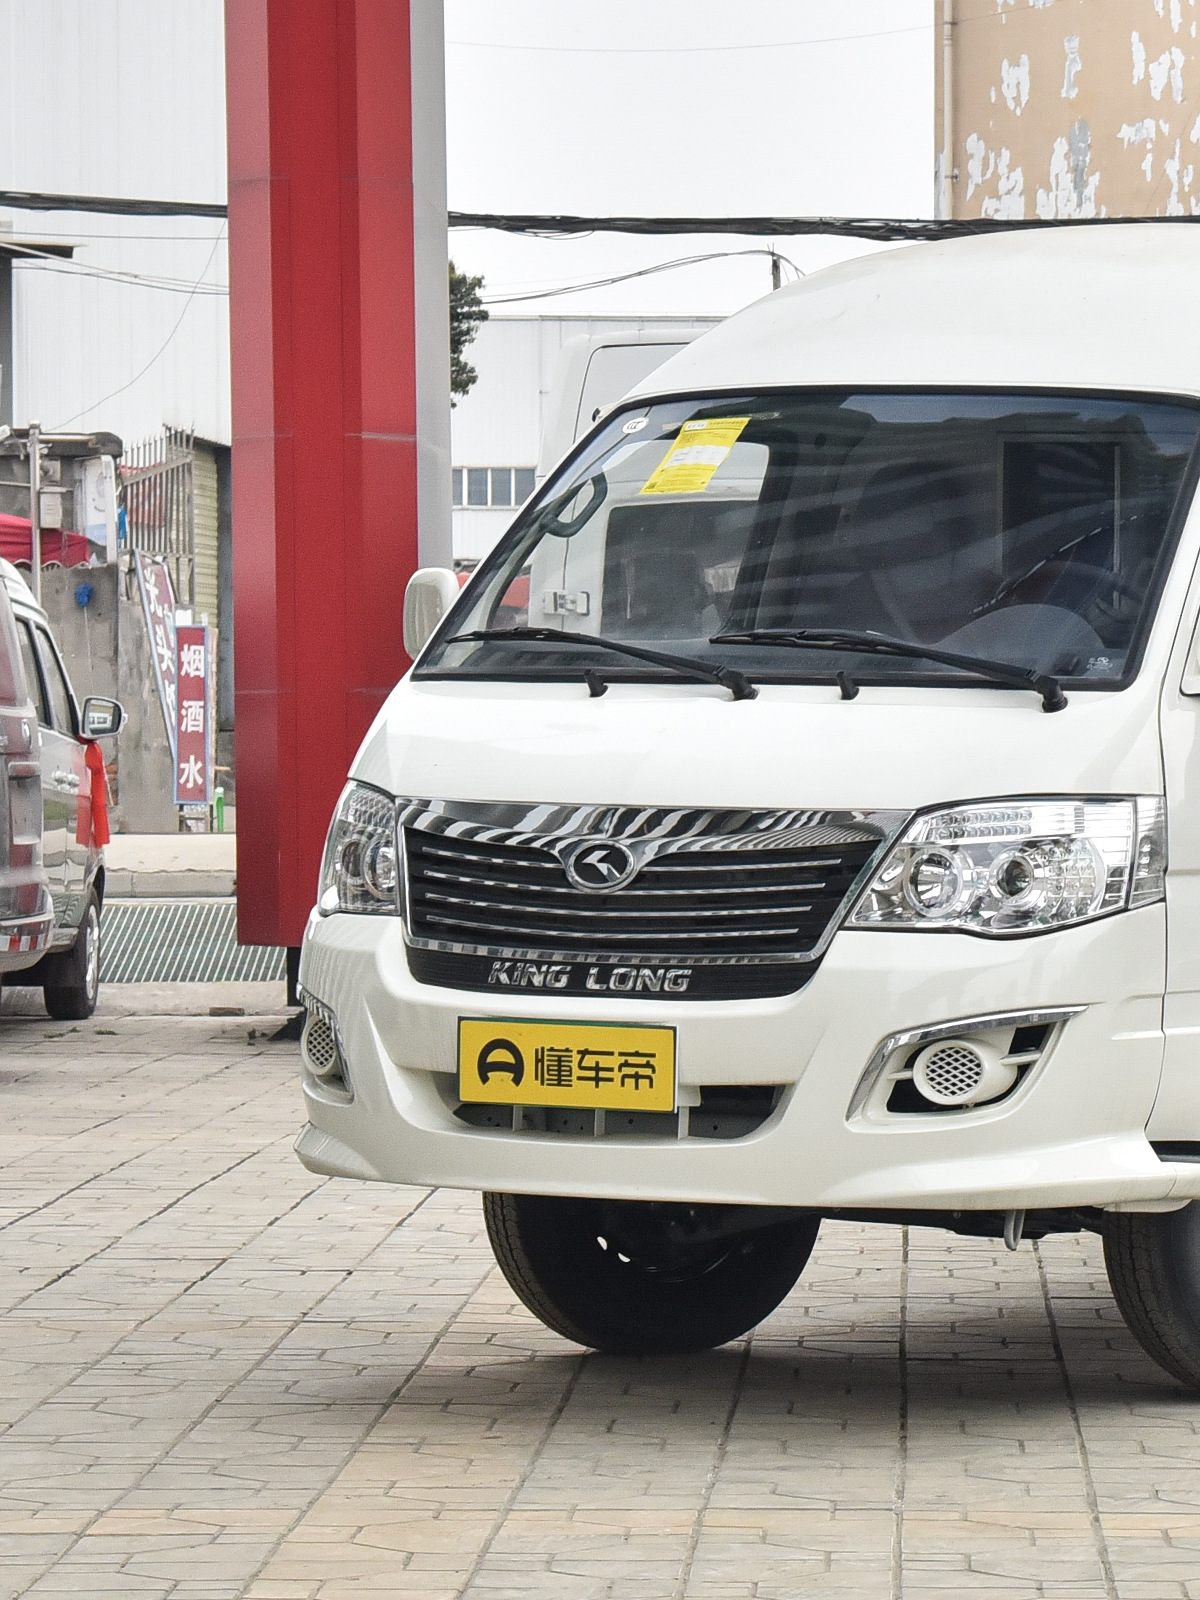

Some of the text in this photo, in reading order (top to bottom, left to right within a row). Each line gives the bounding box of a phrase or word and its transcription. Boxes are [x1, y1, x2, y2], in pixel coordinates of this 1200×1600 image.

[179, 643, 205, 789] 烟酒水
[488, 961, 692, 992] KING LONG
[534, 1046, 657, 1091] 懂车帝
